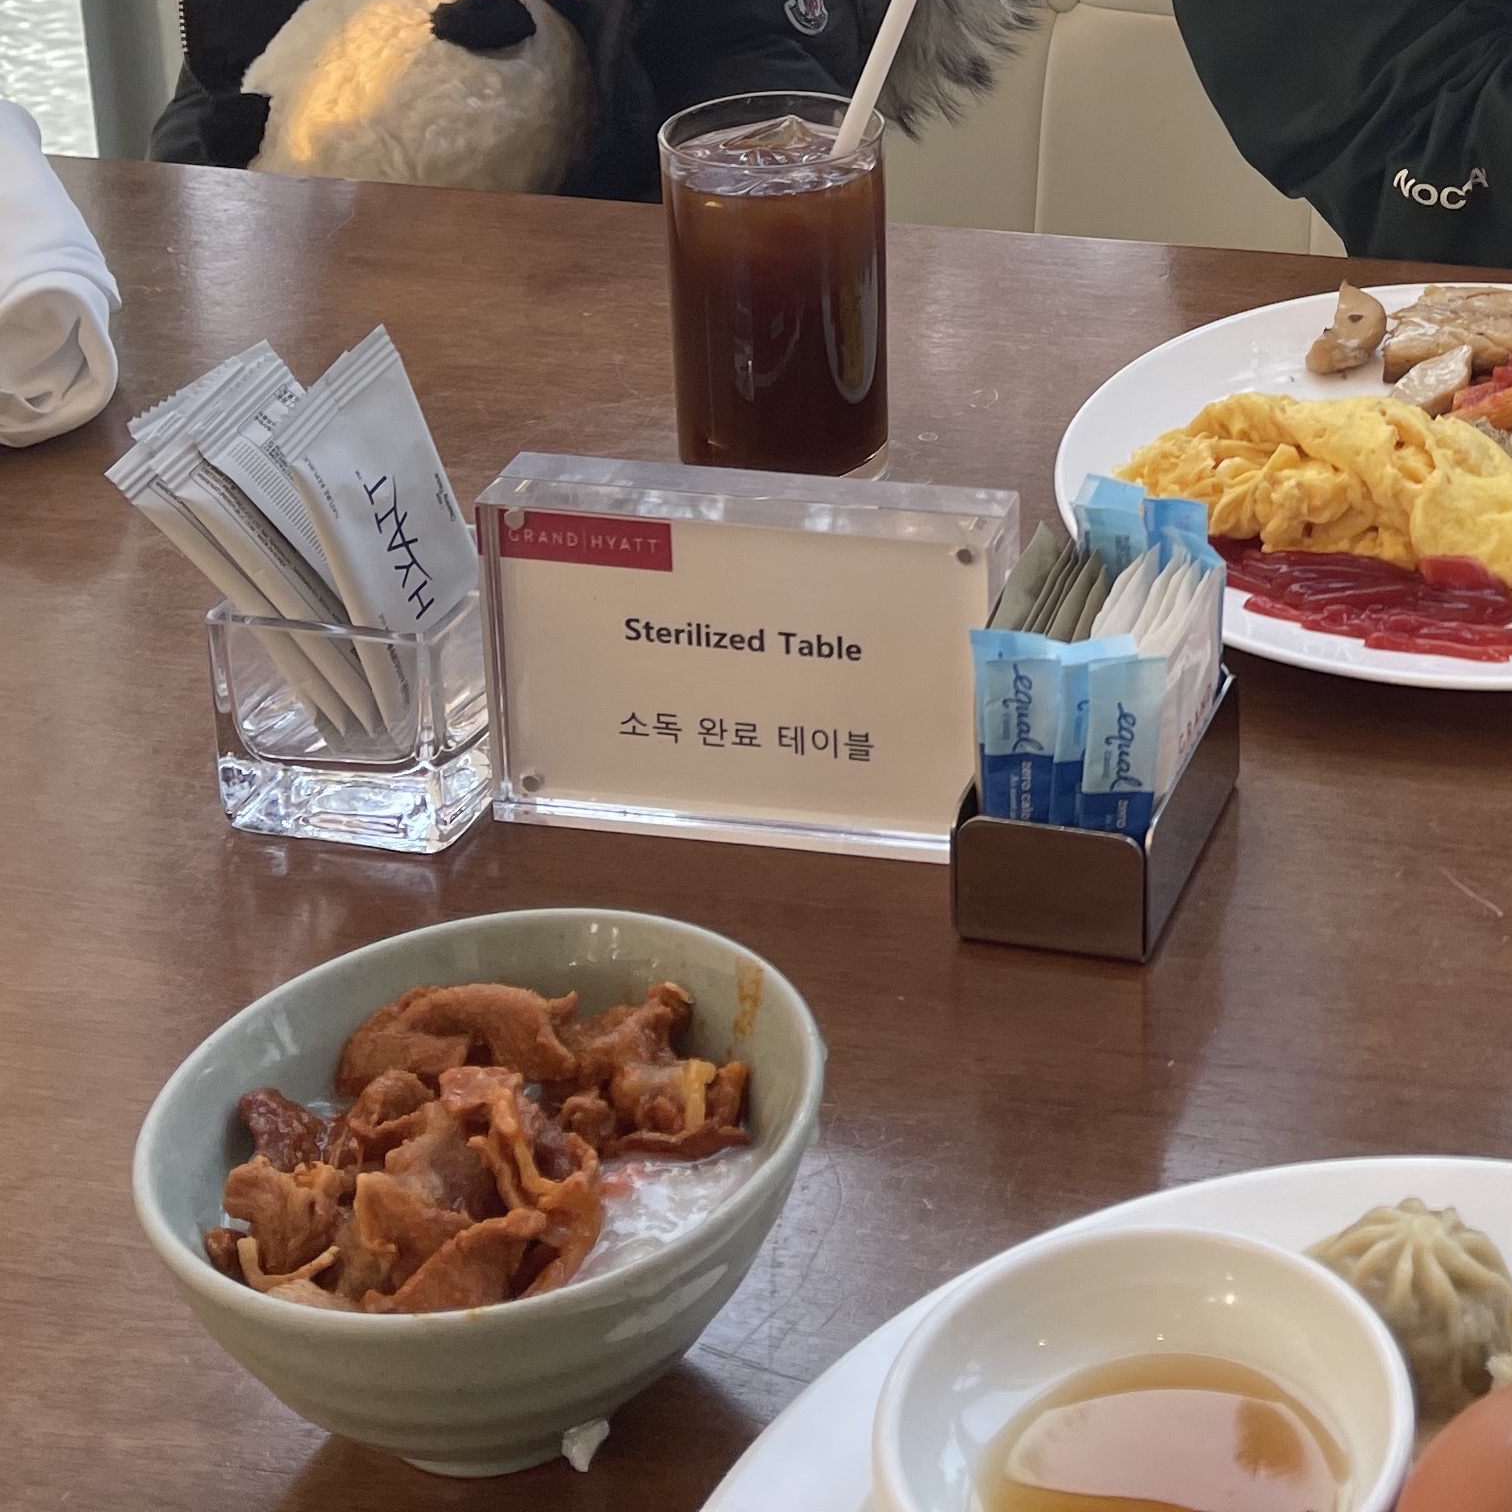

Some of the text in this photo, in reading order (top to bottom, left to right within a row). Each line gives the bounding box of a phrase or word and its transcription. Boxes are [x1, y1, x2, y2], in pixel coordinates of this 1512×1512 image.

[363, 475, 435, 621] HYATT
[508, 528, 663, 554] GRAND HYATT
[624, 618, 863, 661] Sterilized Table
[618, 712, 875, 762] 소독 완료 테이블
[1003, 663, 1044, 752] equal
[1105, 701, 1142, 792] equal
